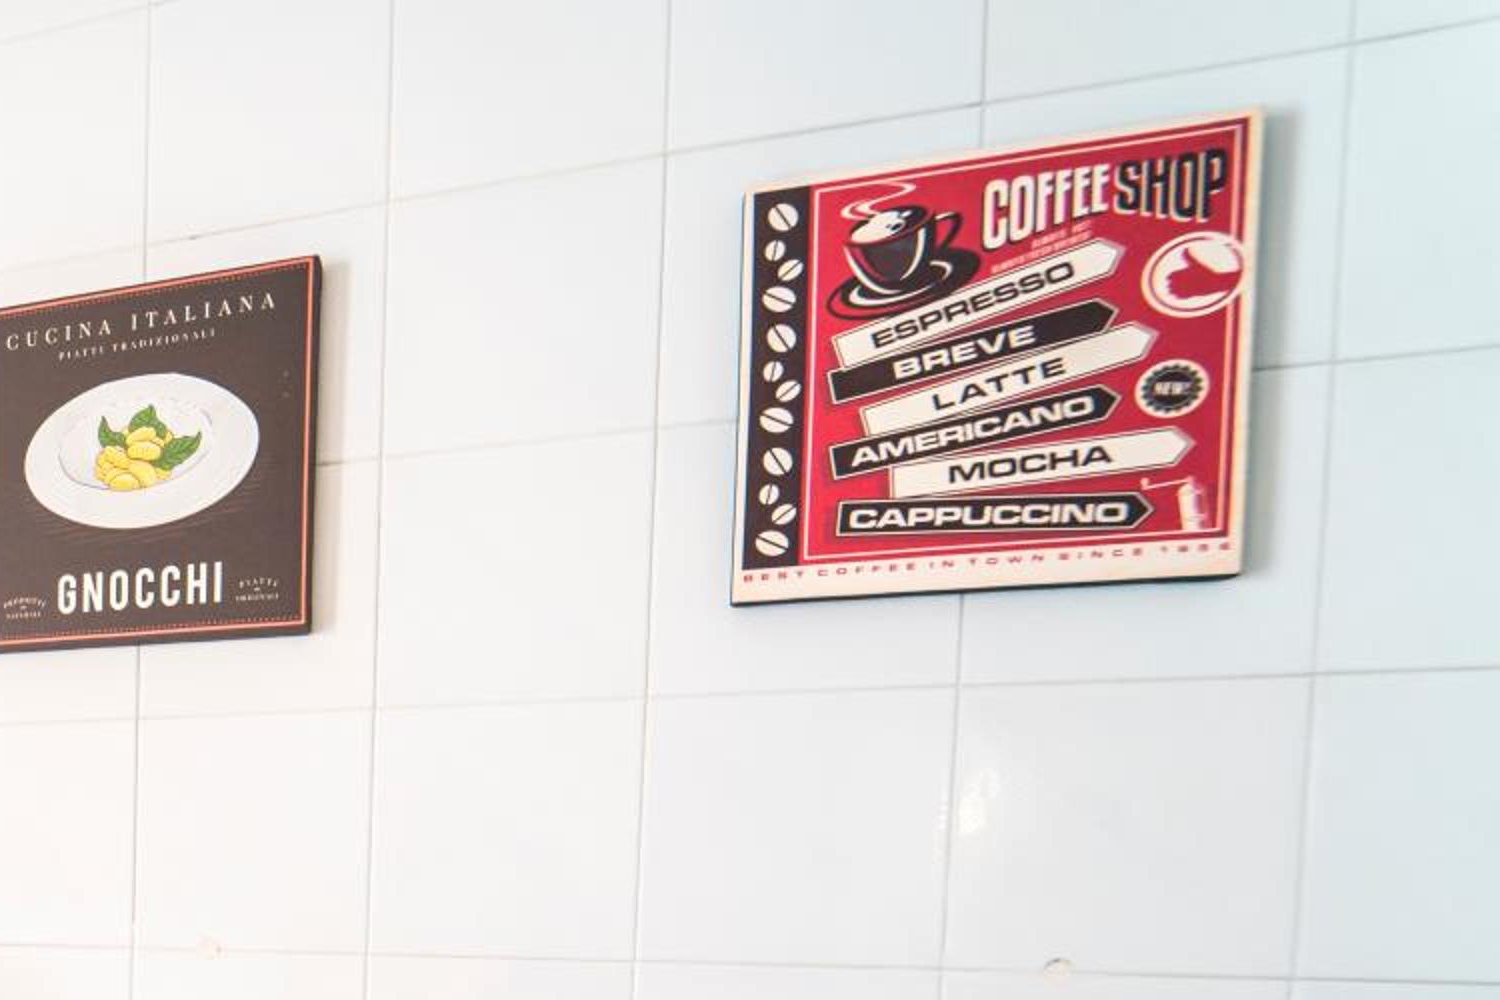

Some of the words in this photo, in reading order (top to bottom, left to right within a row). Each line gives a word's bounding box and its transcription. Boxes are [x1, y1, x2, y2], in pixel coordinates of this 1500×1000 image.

[983, 163, 1111, 250] COFFEE
[1113, 147, 1228, 223] SHOP
[6, 319, 112, 351] CUCINA
[130, 291, 276, 331] ITALIANA
[870, 262, 1074, 349] ESPRESSO
[112, 328, 216, 352] TRADIZIONALI
[893, 325, 1036, 380] BREVE
[931, 357, 1066, 411] LATTE
[851, 395, 1094, 467] AMERICANO
[949, 446, 1112, 484] MOCHA
[849, 502, 1128, 530] CAPPUCCINO
[57, 561, 223, 615] GNOCCHI
[817, 562, 916, 577] COFFEE
[968, 552, 1045, 566] TOWN
